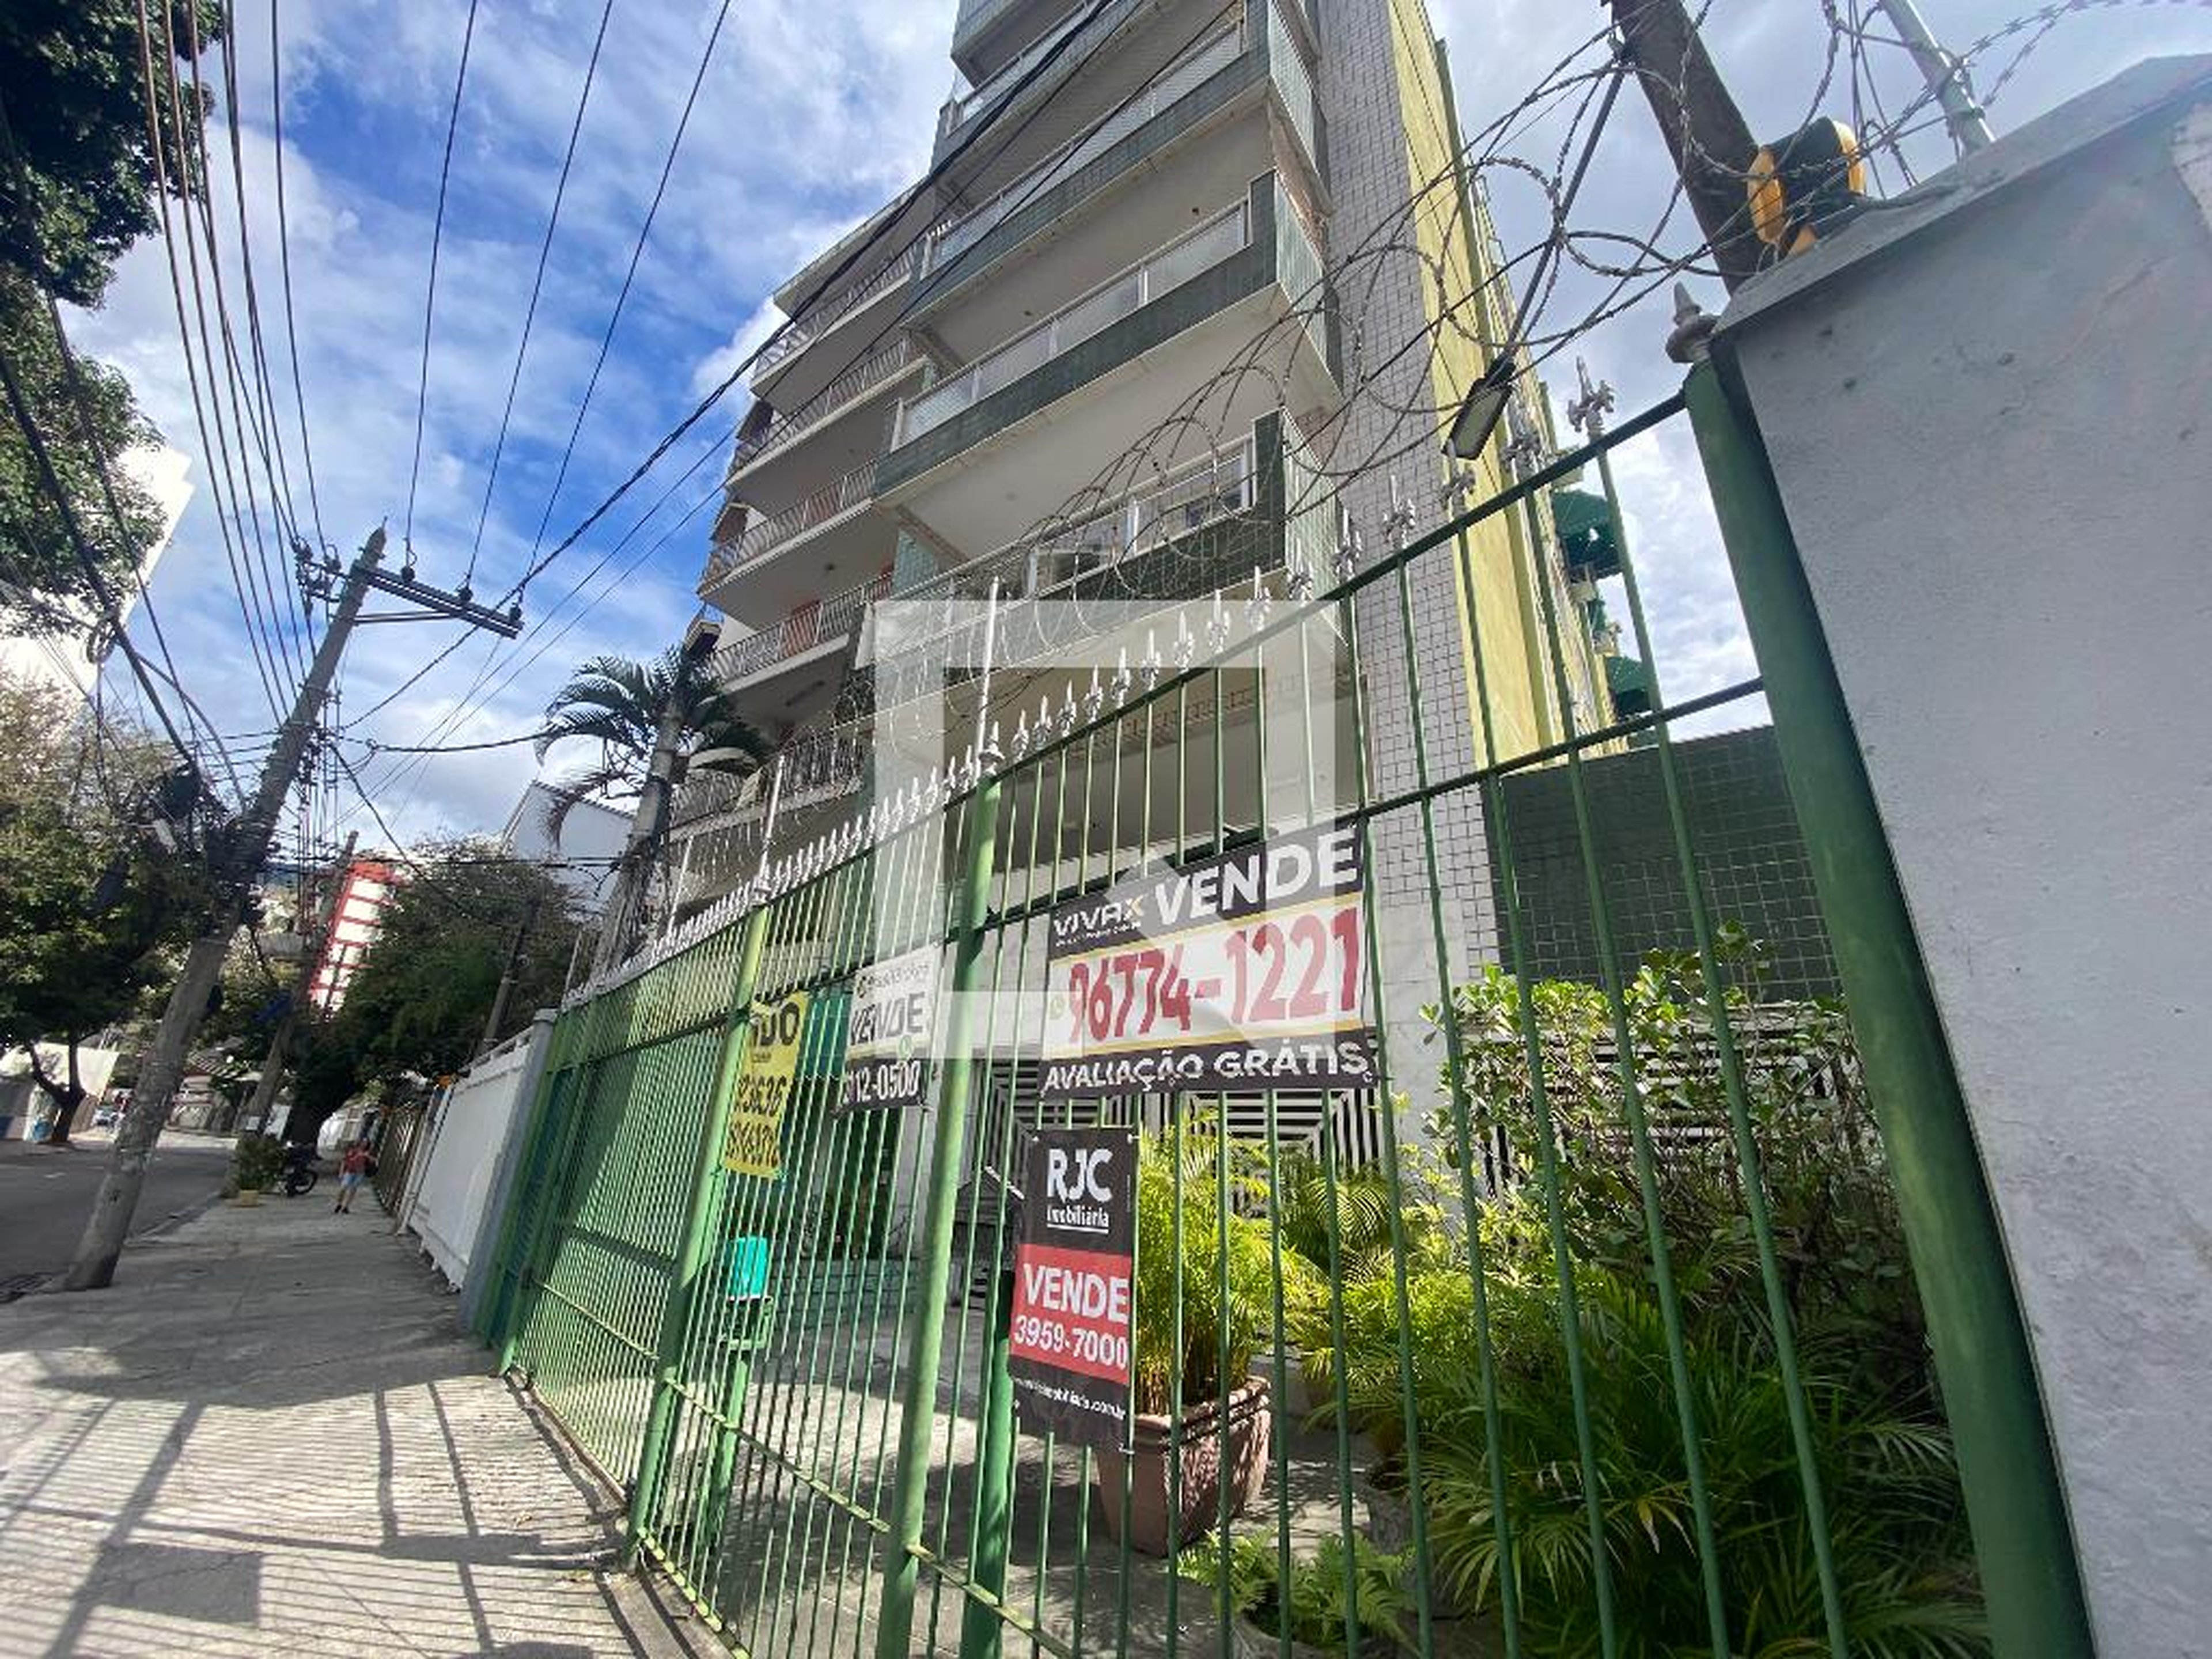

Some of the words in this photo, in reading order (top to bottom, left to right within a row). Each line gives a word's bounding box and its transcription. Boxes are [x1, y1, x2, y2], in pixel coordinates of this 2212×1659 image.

[1155, 830, 1358, 925] VENDE
[1069, 907, 1358, 1043] 96774-1221
[850, 991, 925, 1046] VENDE
[1043, 1050, 1204, 1092] AVALIAÇÃO
[1214, 1039, 1368, 1078] GRÁTIS
[1046, 1148, 1113, 1203] RJC
[1023, 1263, 1129, 1324] VENDE
[1014, 1315, 1128, 1370] 3959-7000
